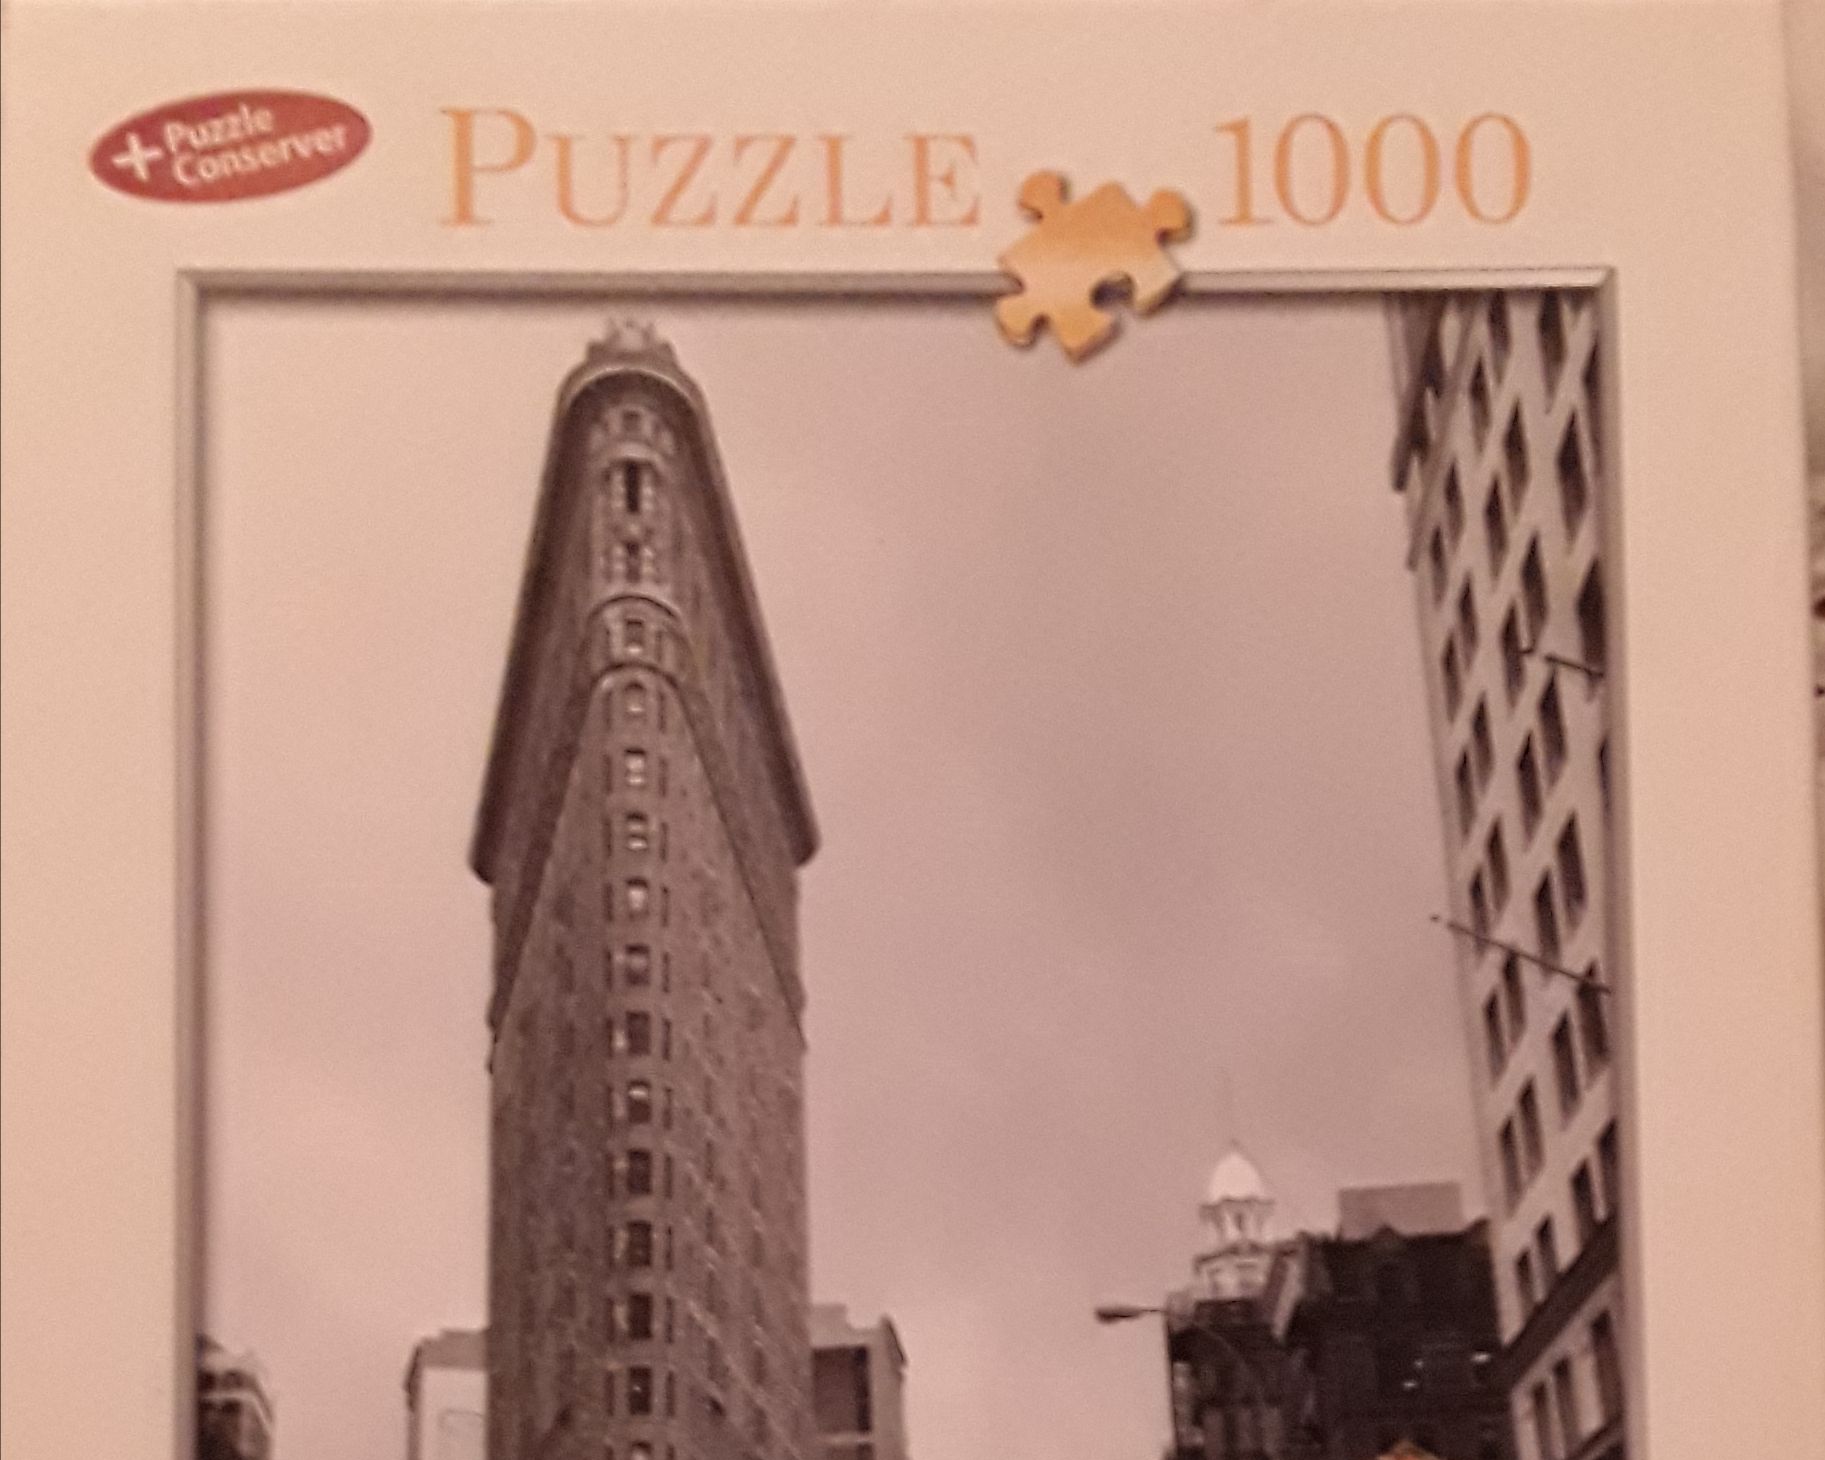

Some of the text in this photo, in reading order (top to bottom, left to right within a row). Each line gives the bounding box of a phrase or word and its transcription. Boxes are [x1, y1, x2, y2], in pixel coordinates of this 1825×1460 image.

[163, 102, 274, 153] Puzzle
[173, 122, 346, 187] Conserver
[438, 107, 1532, 230] PUZZLE 1000
